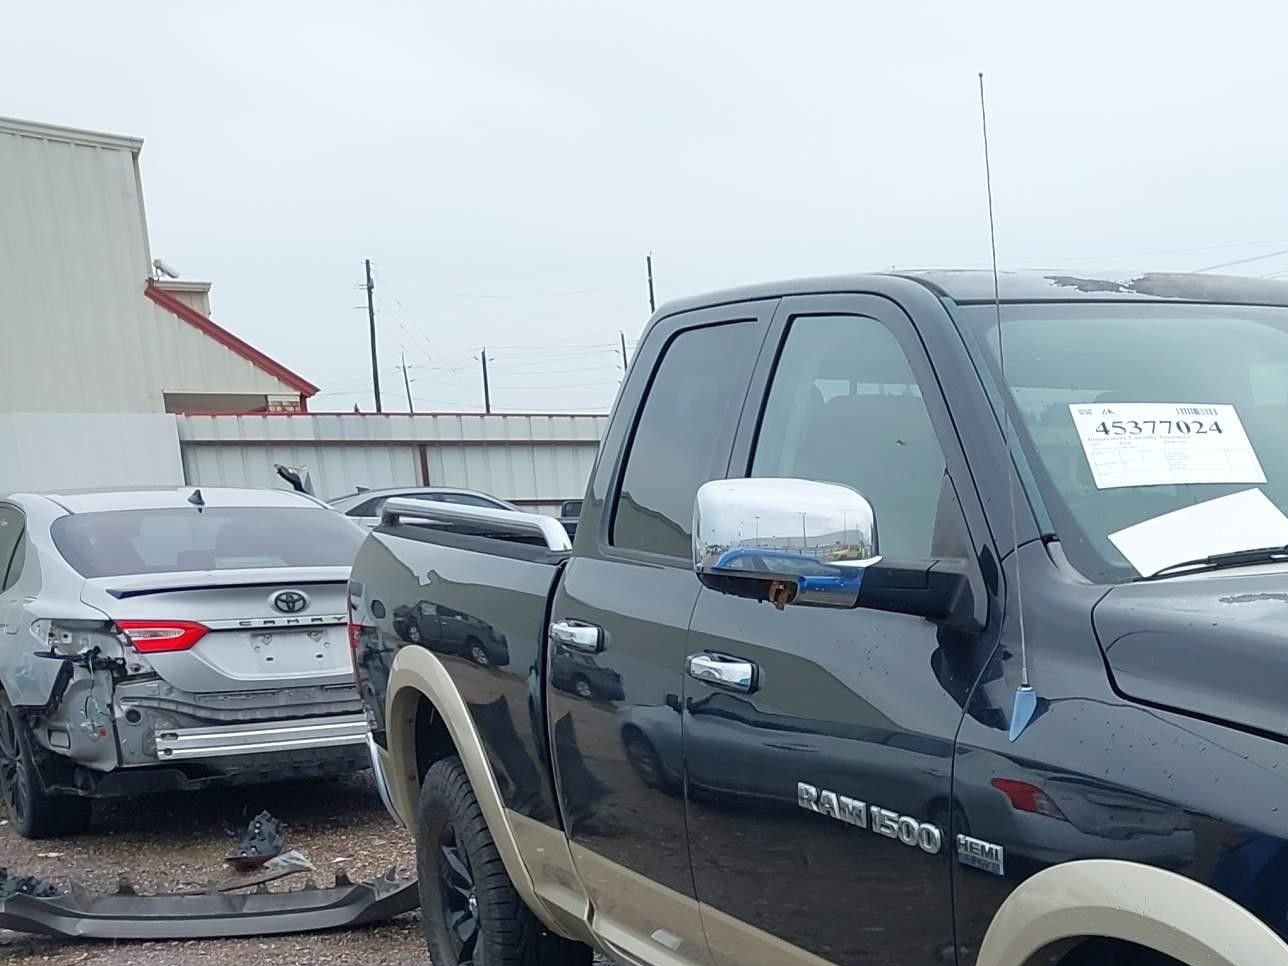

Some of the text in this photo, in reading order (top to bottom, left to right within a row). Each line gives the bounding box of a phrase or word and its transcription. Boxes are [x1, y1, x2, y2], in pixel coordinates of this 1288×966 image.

[1095, 420, 1223, 436] 45377024
[239, 615, 346, 627] CAMRY
[797, 781, 943, 855] RAM 1500
[957, 835, 1002, 862] HEMI
